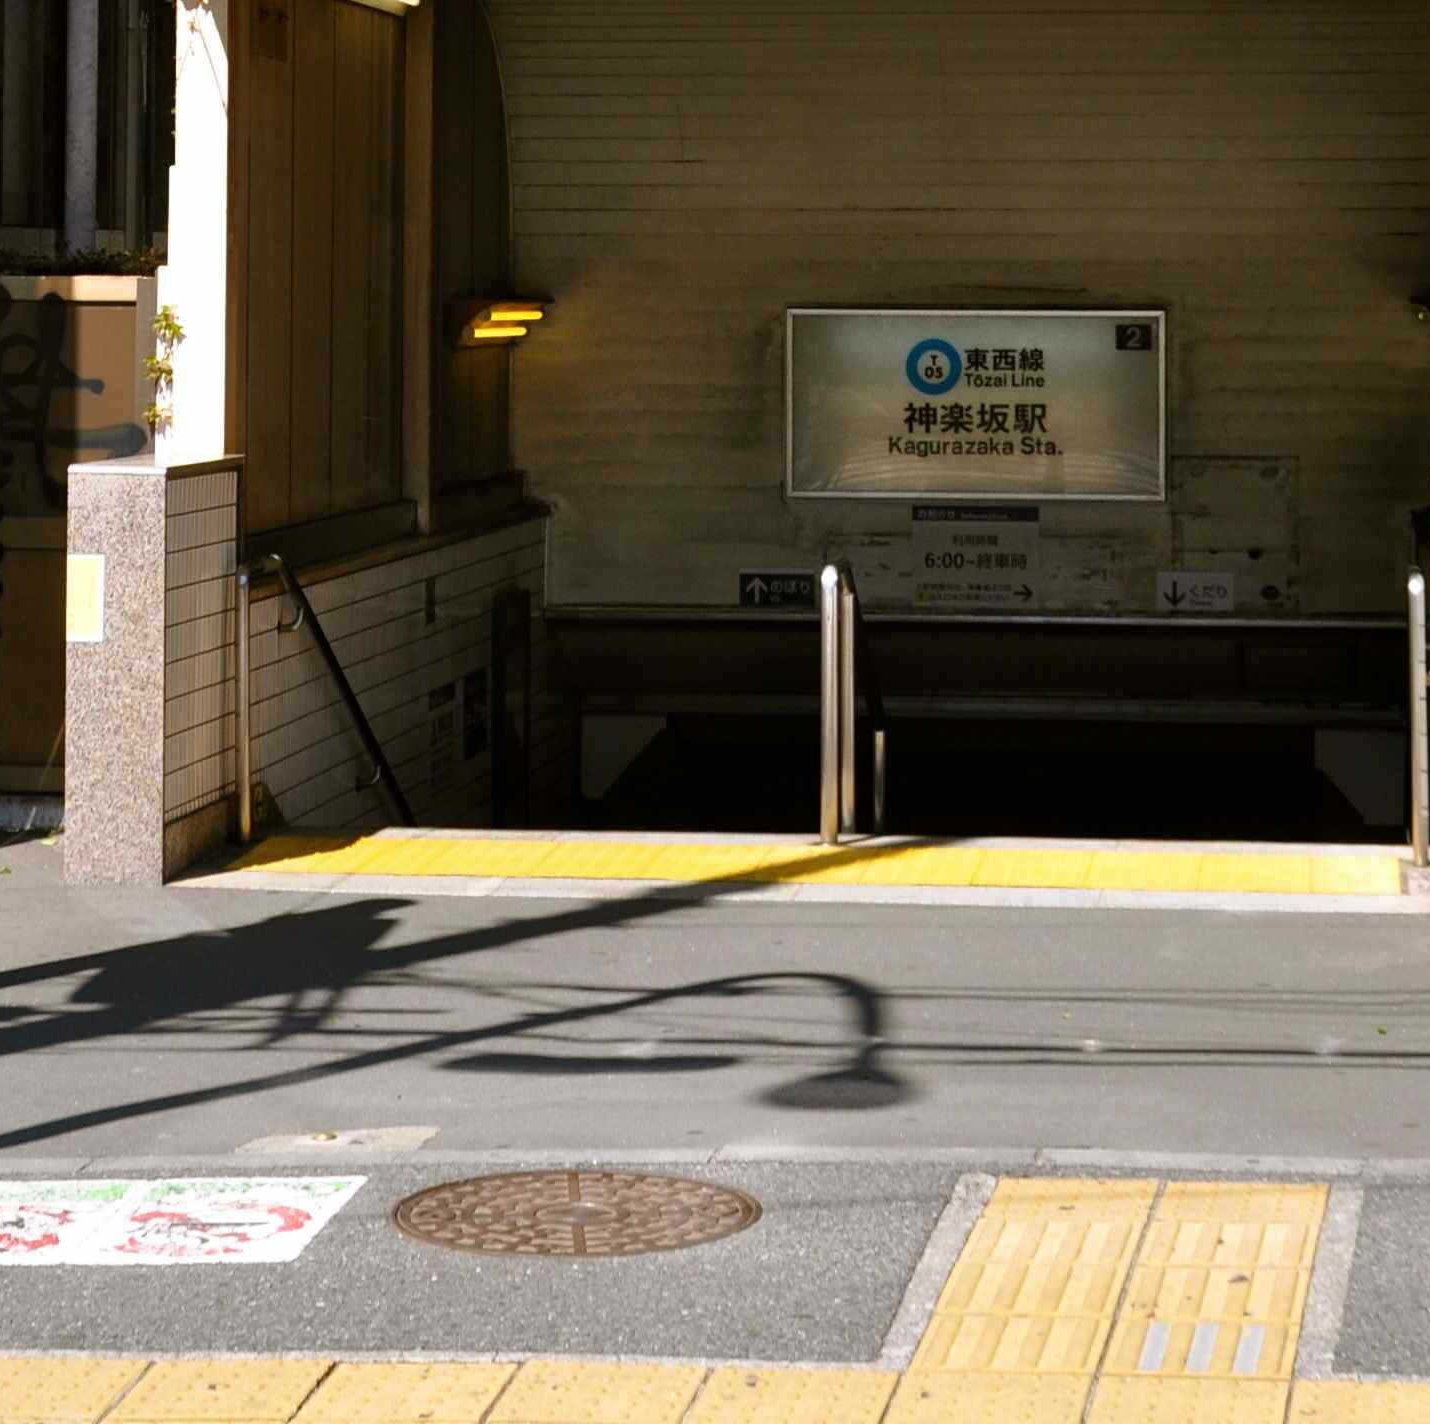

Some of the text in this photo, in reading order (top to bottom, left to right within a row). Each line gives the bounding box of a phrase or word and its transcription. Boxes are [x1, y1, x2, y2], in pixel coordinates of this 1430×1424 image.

[1124, 328, 1140, 348] 2
[929, 354, 938, 366] T
[964, 347, 1045, 372] 東西線
[1011, 372, 1045, 388] Line
[904, 402, 1048, 434] 神楽坂駅
[888, 436, 1064, 459] Kagurazaka Sta.
